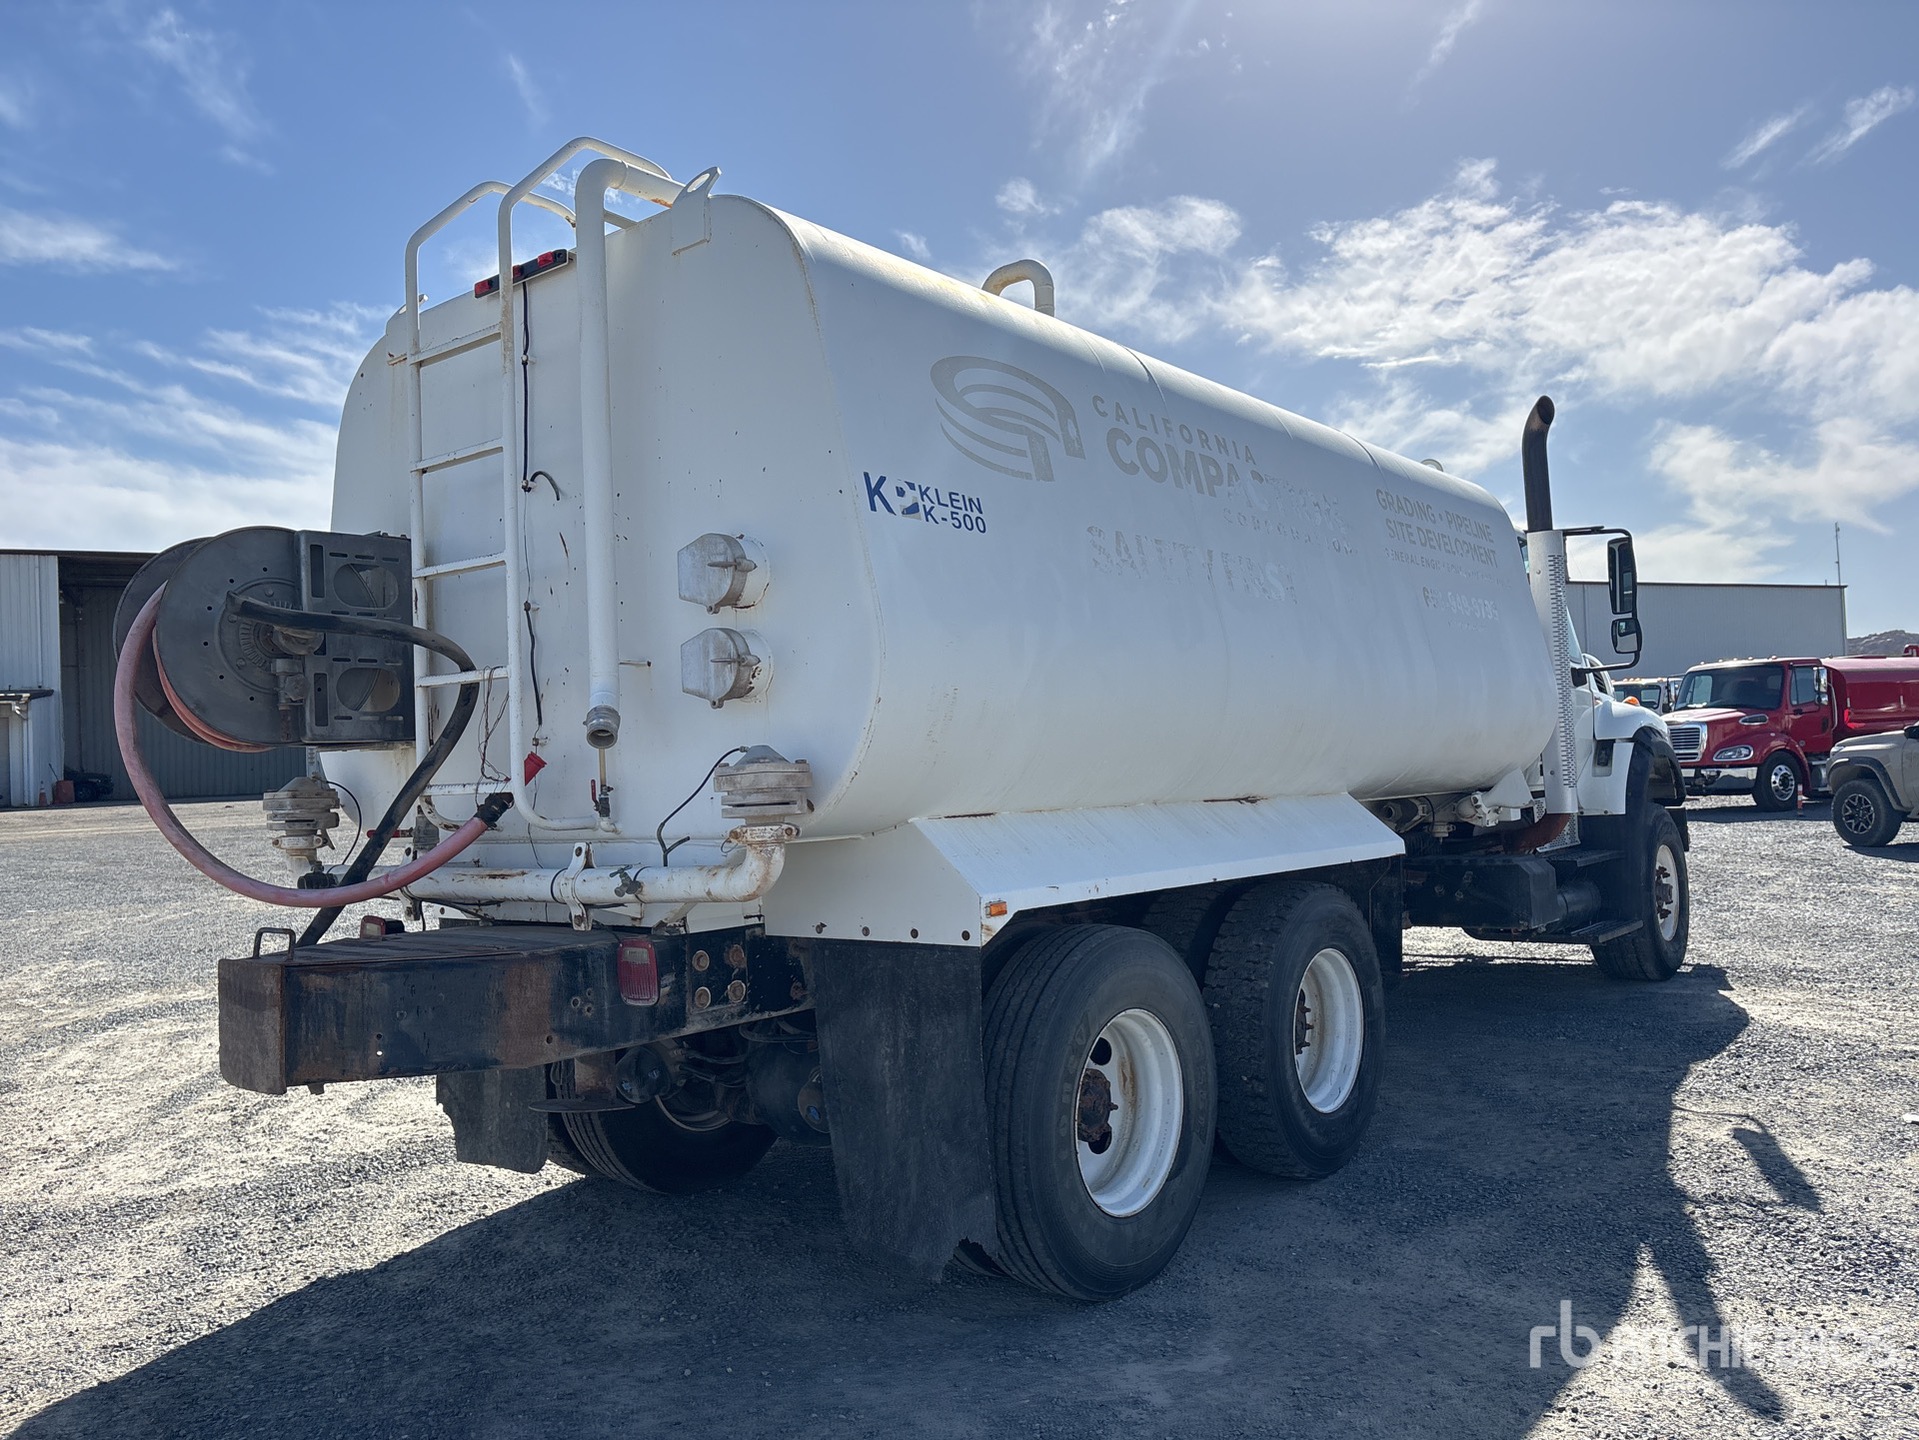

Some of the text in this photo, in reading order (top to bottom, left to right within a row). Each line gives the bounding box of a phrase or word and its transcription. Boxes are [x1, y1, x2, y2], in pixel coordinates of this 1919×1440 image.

[1092, 395, 1257, 466] CALIFORNIA
[918, 484, 983, 515] KLEIN
[922, 504, 987, 534] K-500
[1376, 489, 1495, 544] GRADING PIPELINE
[1386, 519, 1498, 568] SITE DEVELOPMENT
